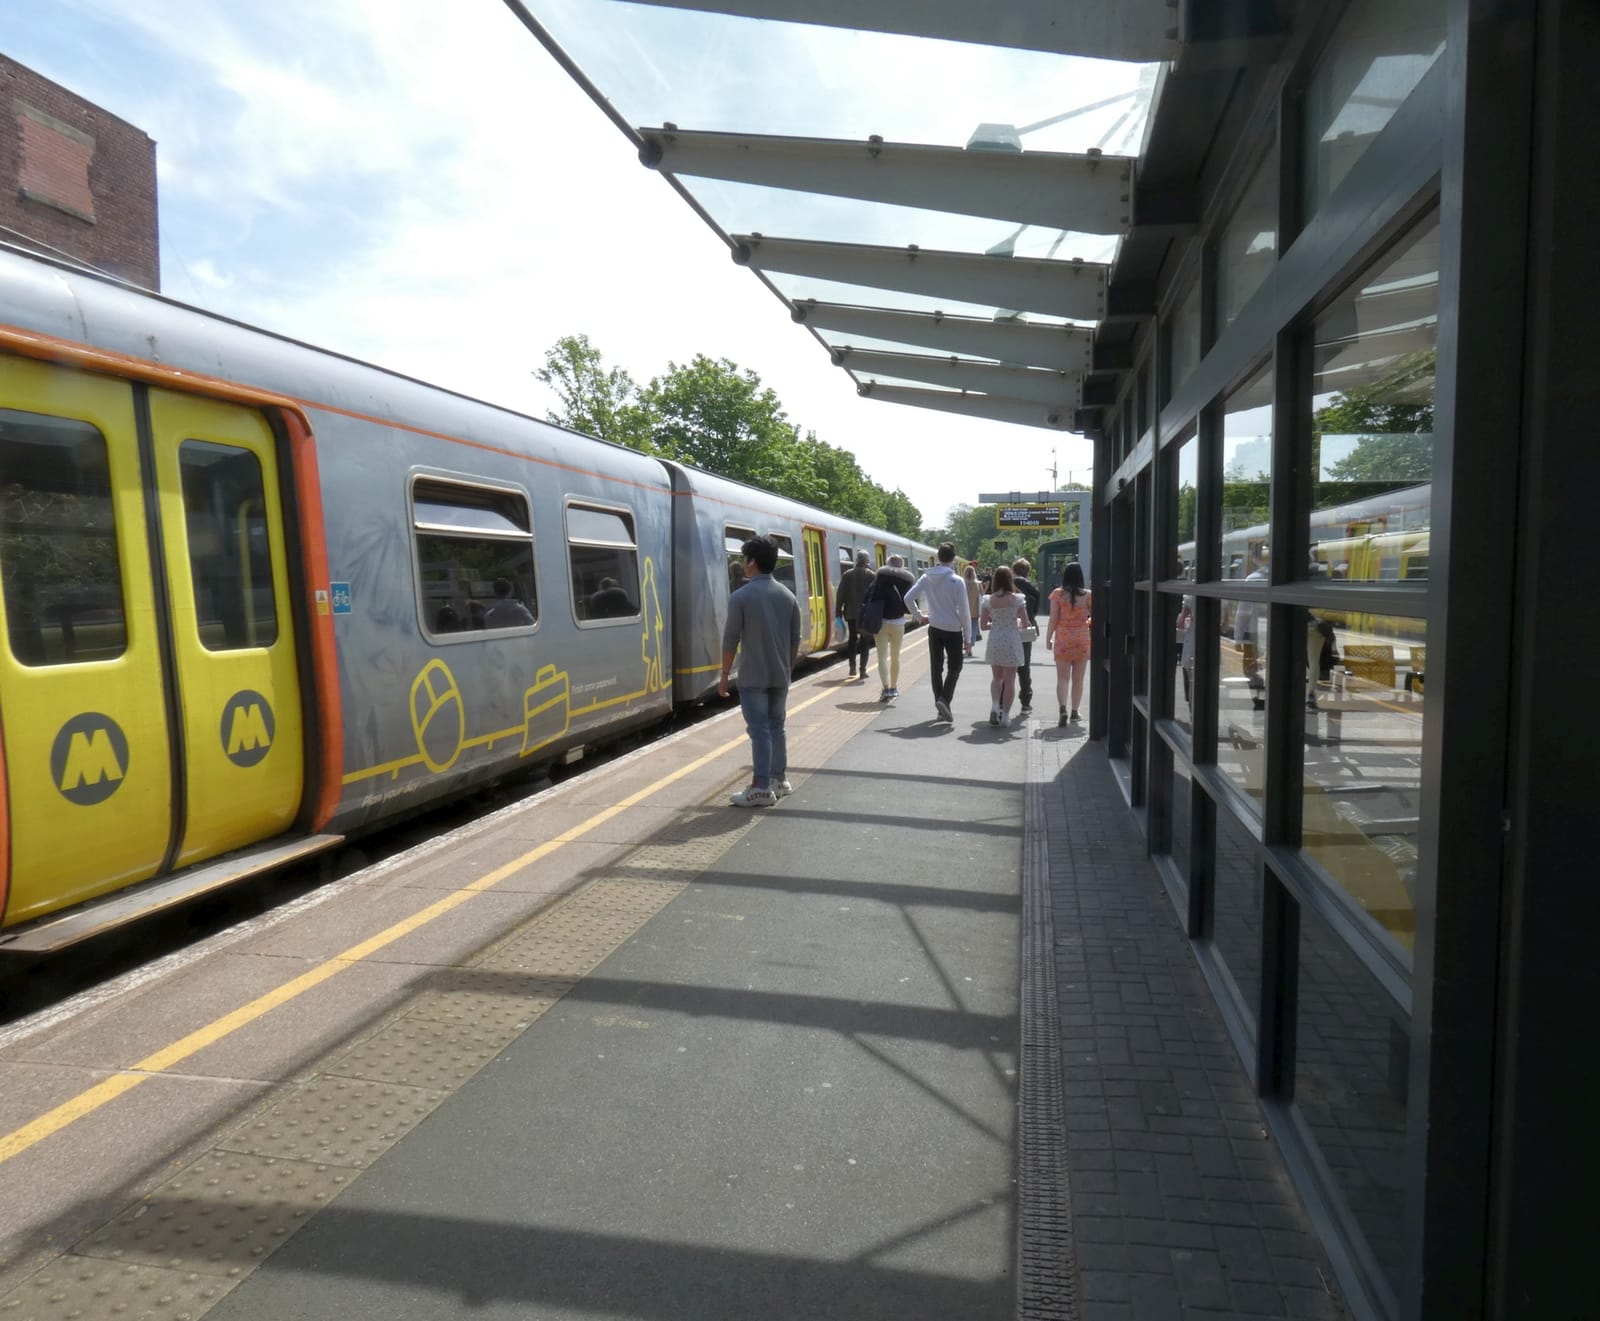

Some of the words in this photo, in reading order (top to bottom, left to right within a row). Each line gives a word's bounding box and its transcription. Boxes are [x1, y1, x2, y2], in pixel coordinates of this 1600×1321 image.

[227, 703, 271, 755] M
[60, 728, 124, 791] M
[361, 794, 383, 808] Plan
